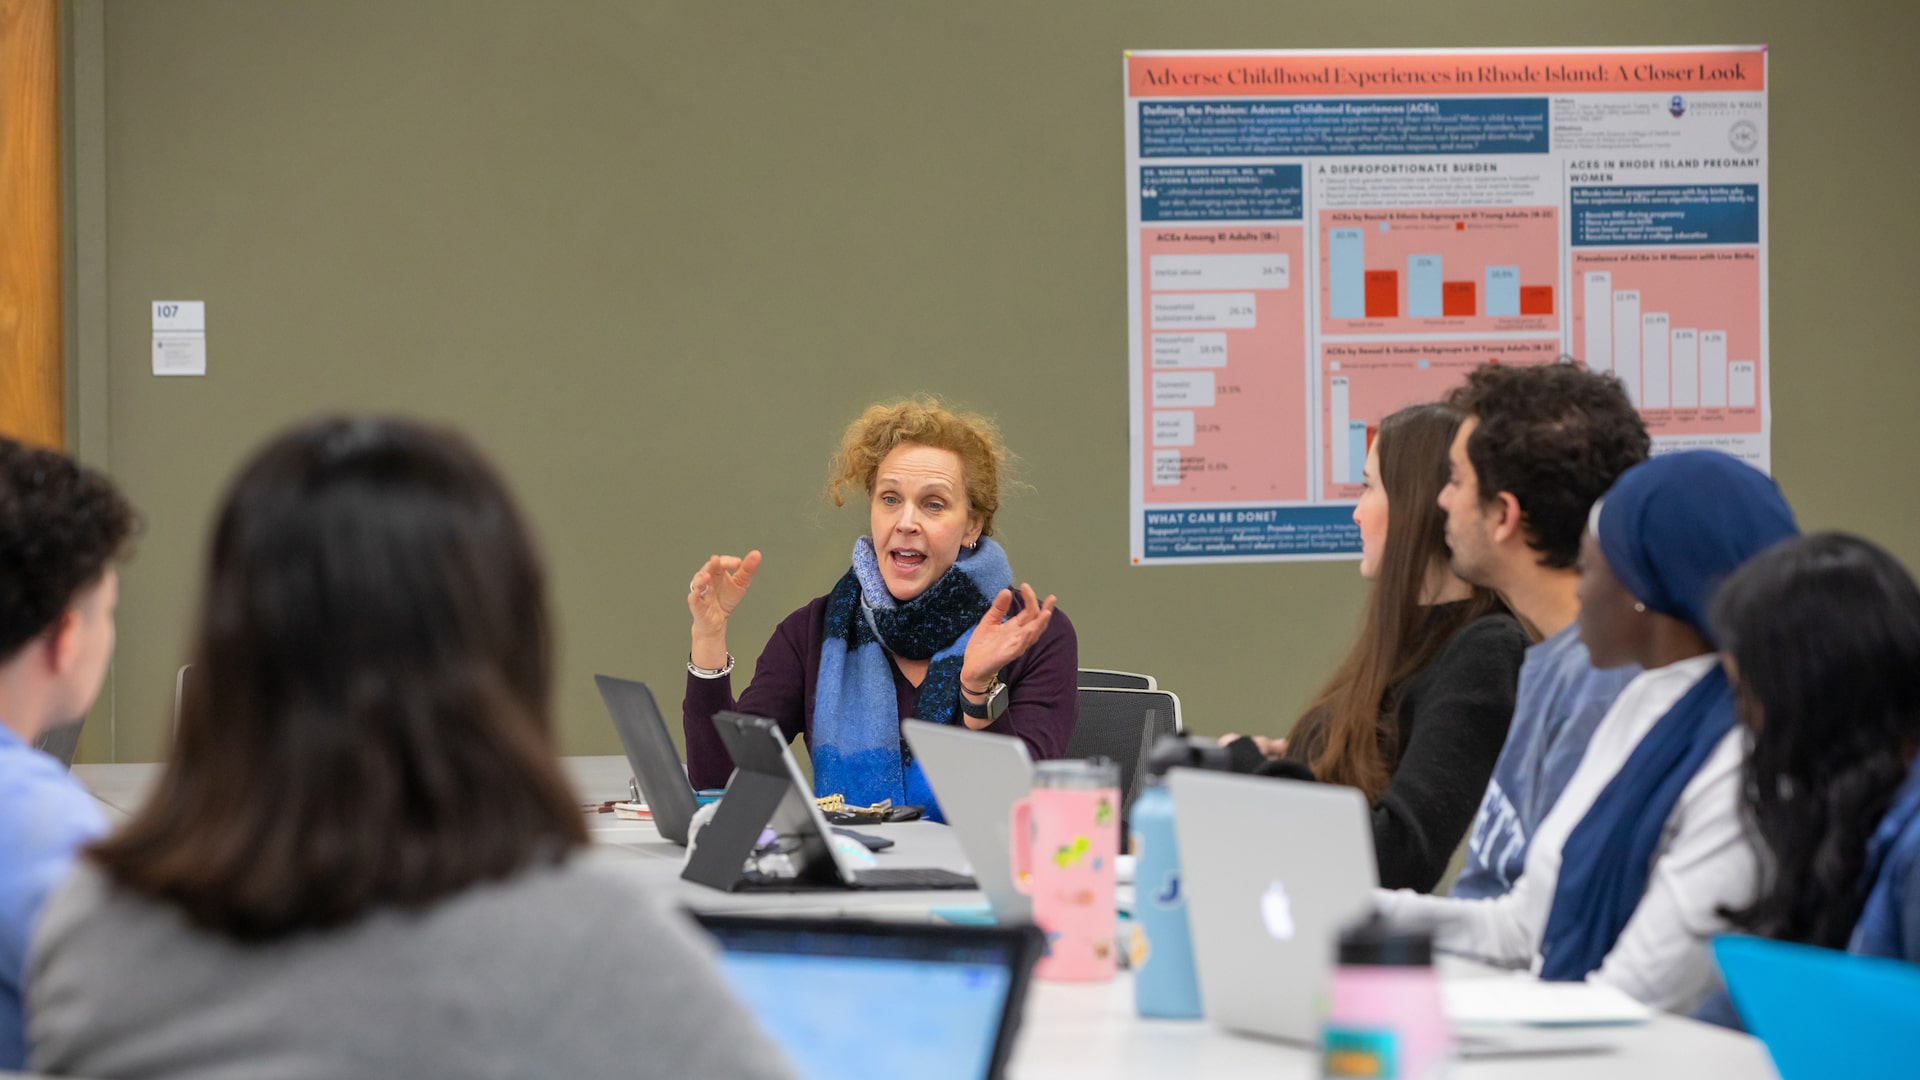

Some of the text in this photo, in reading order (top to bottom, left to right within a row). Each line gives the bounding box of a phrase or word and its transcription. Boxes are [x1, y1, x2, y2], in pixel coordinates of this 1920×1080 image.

[1142, 63, 1746, 88] Adverse Childhood Experiences in Rhode Island: A Closer Look
[1143, 104, 1440, 117] Defining the Problem: Adverse Childhood Experiences (ACEs)
[1319, 164, 1497, 174] A DISPROPORTIONATE BURDEN
[1570, 161, 1600, 169] ACES
[1604, 160, 1615, 168] IN
[1619, 160, 1655, 168] RHODE
[1659, 160, 1699, 168] ISLAND
[1570, 174, 1613, 182] WOMEN
[1183, 233, 1215, 243] Among
[1218, 233, 1226, 241] RI
[1228, 233, 1258, 241] Adults
[157, 304, 179, 318] 107
[1148, 511, 1277, 523] WHAT CAN BE DONE?
